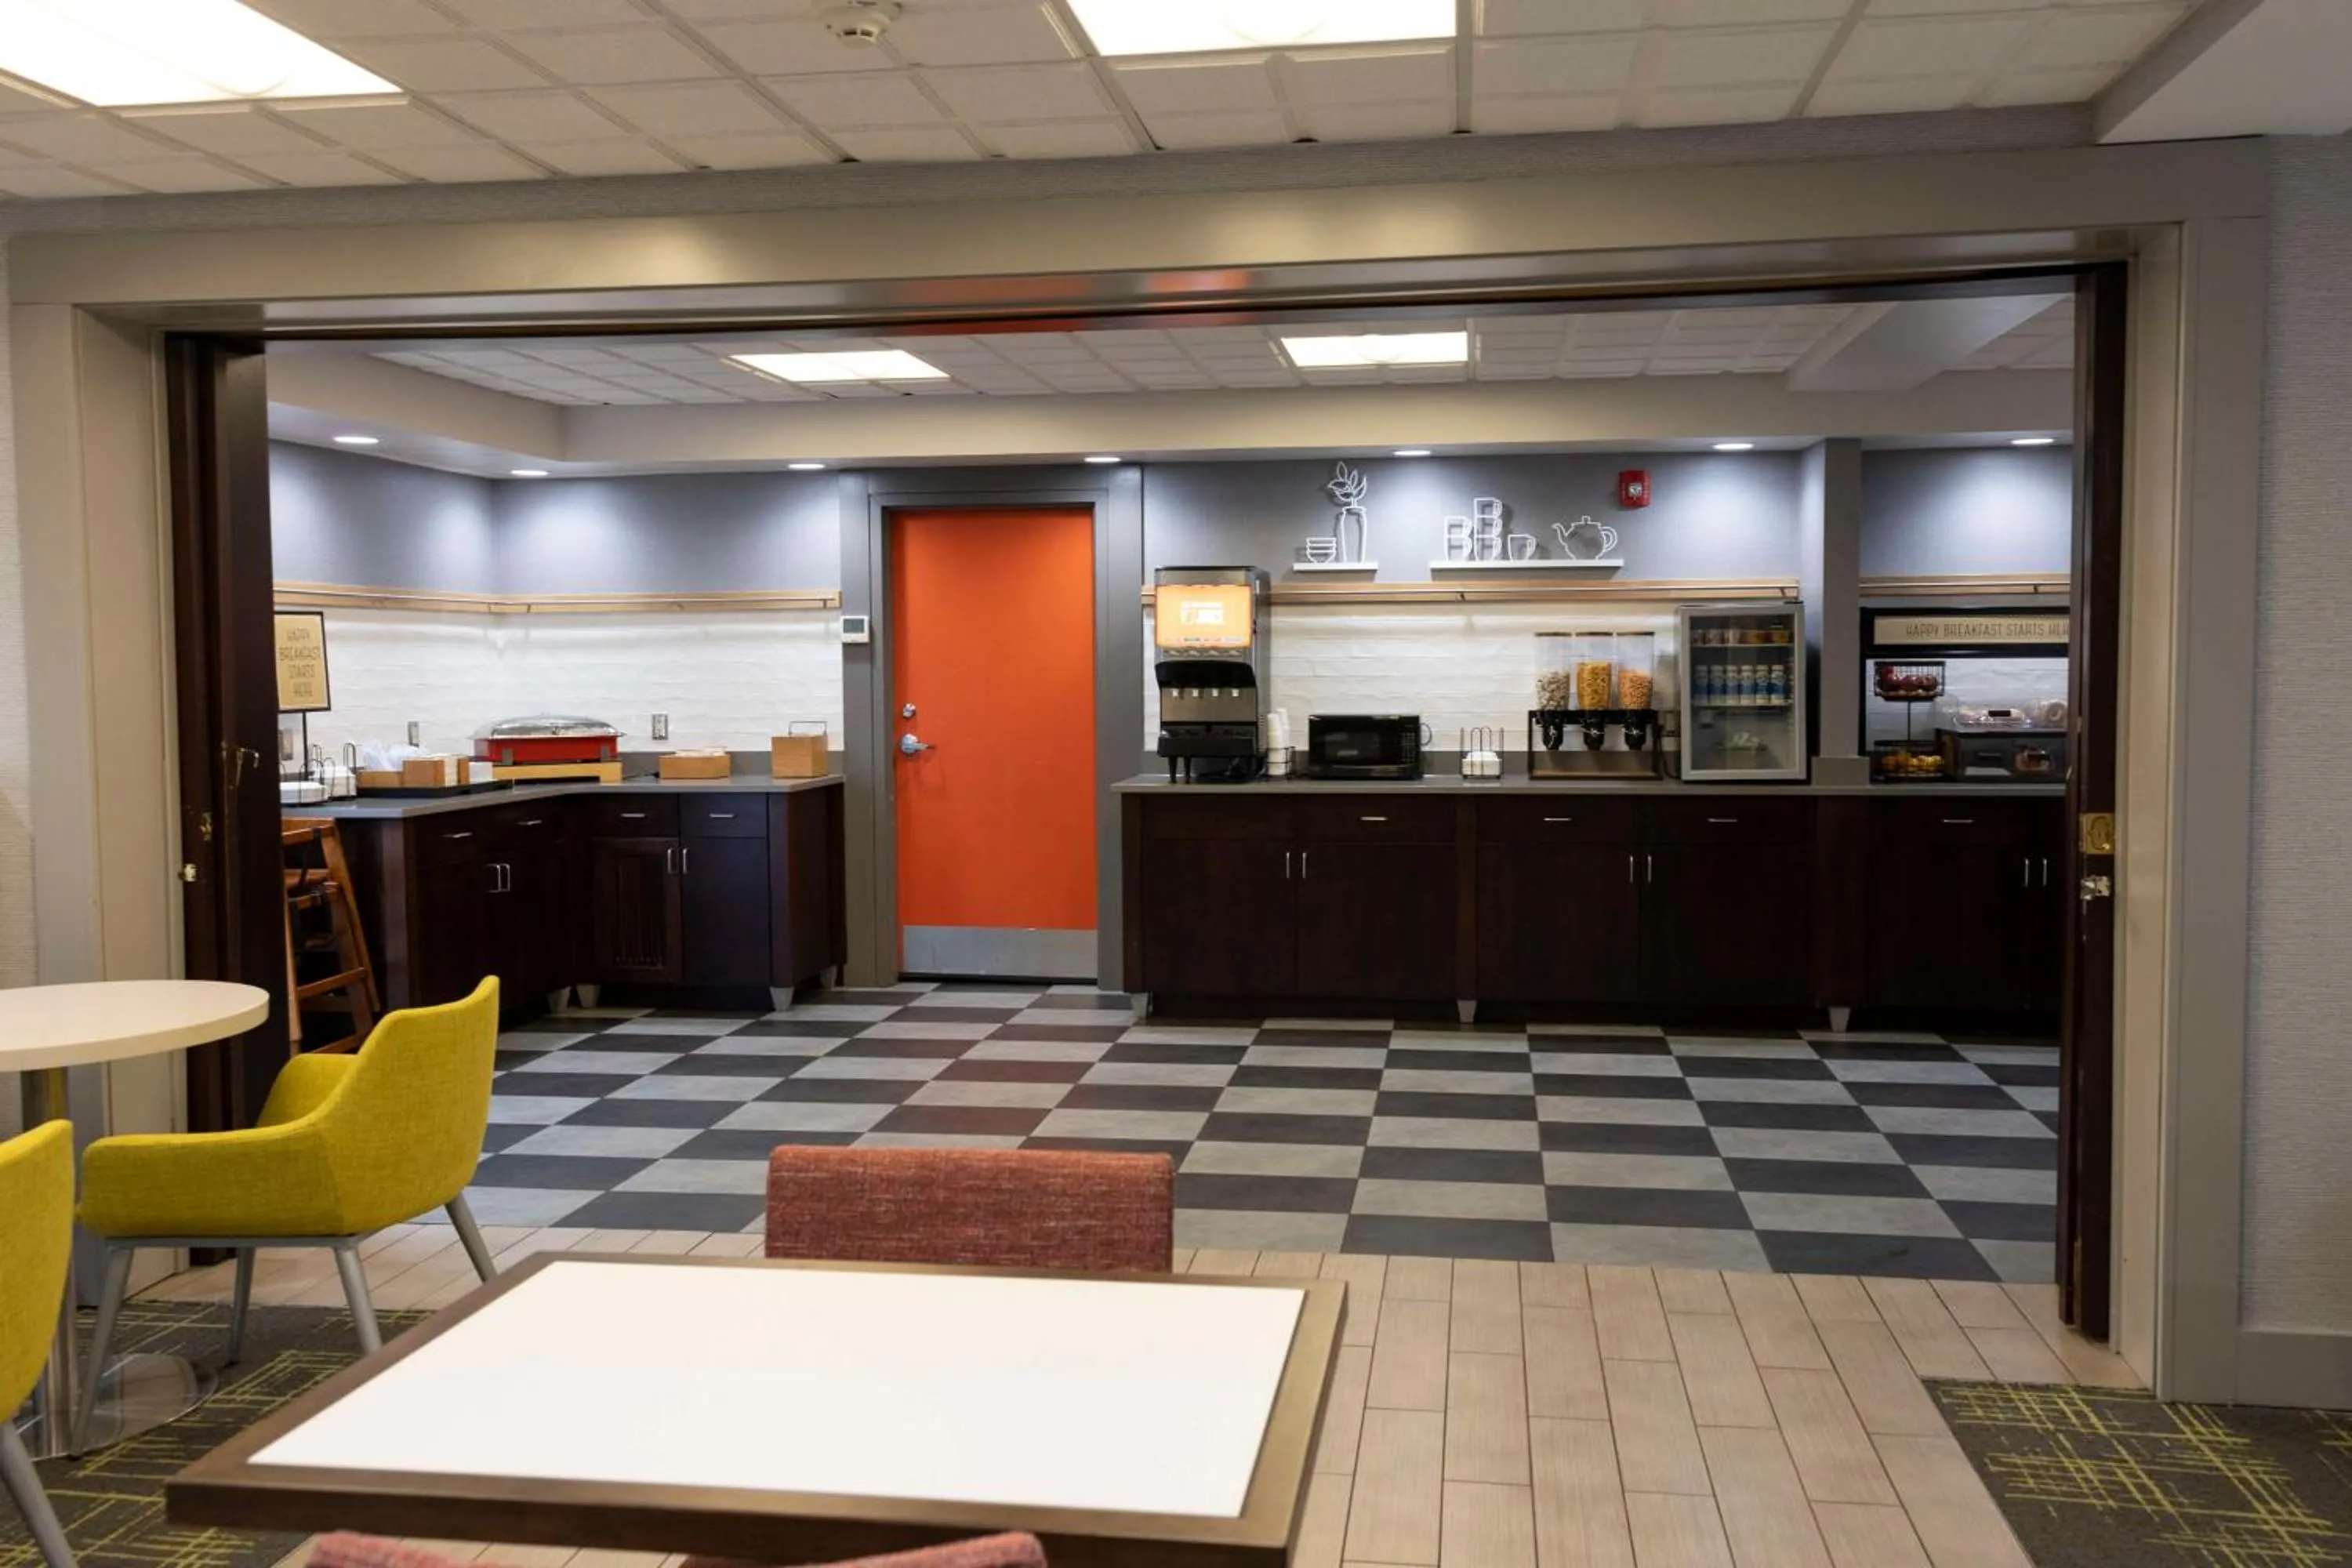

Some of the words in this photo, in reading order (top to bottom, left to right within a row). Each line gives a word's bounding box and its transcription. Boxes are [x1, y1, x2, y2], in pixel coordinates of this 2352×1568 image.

[1907, 623, 1939, 637] HAPPY
[1944, 623, 2002, 637] BREAKFAST
[2006, 622, 2044, 636] STARTS
